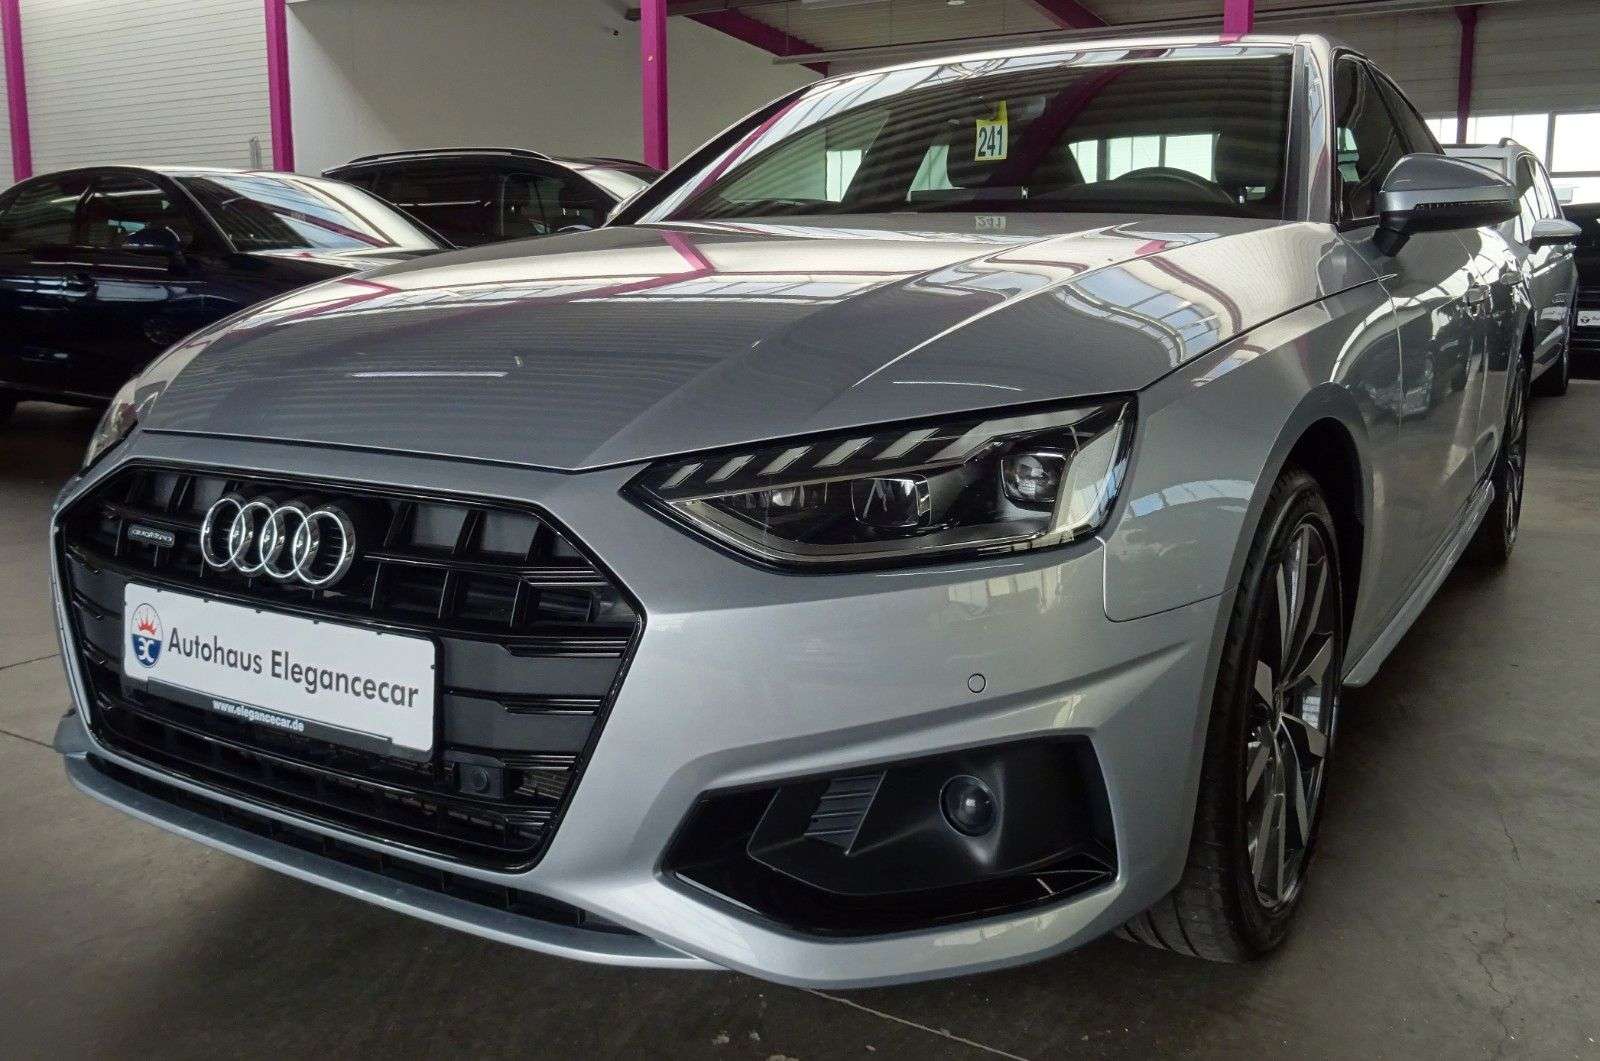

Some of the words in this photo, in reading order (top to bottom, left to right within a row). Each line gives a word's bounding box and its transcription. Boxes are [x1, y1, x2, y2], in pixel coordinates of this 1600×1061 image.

[977, 125, 1003, 157] 241
[168, 627, 262, 675] Autohaus
[270, 650, 419, 708] Elegancecar
[212, 699, 305, 732] www.elegancecar.de
